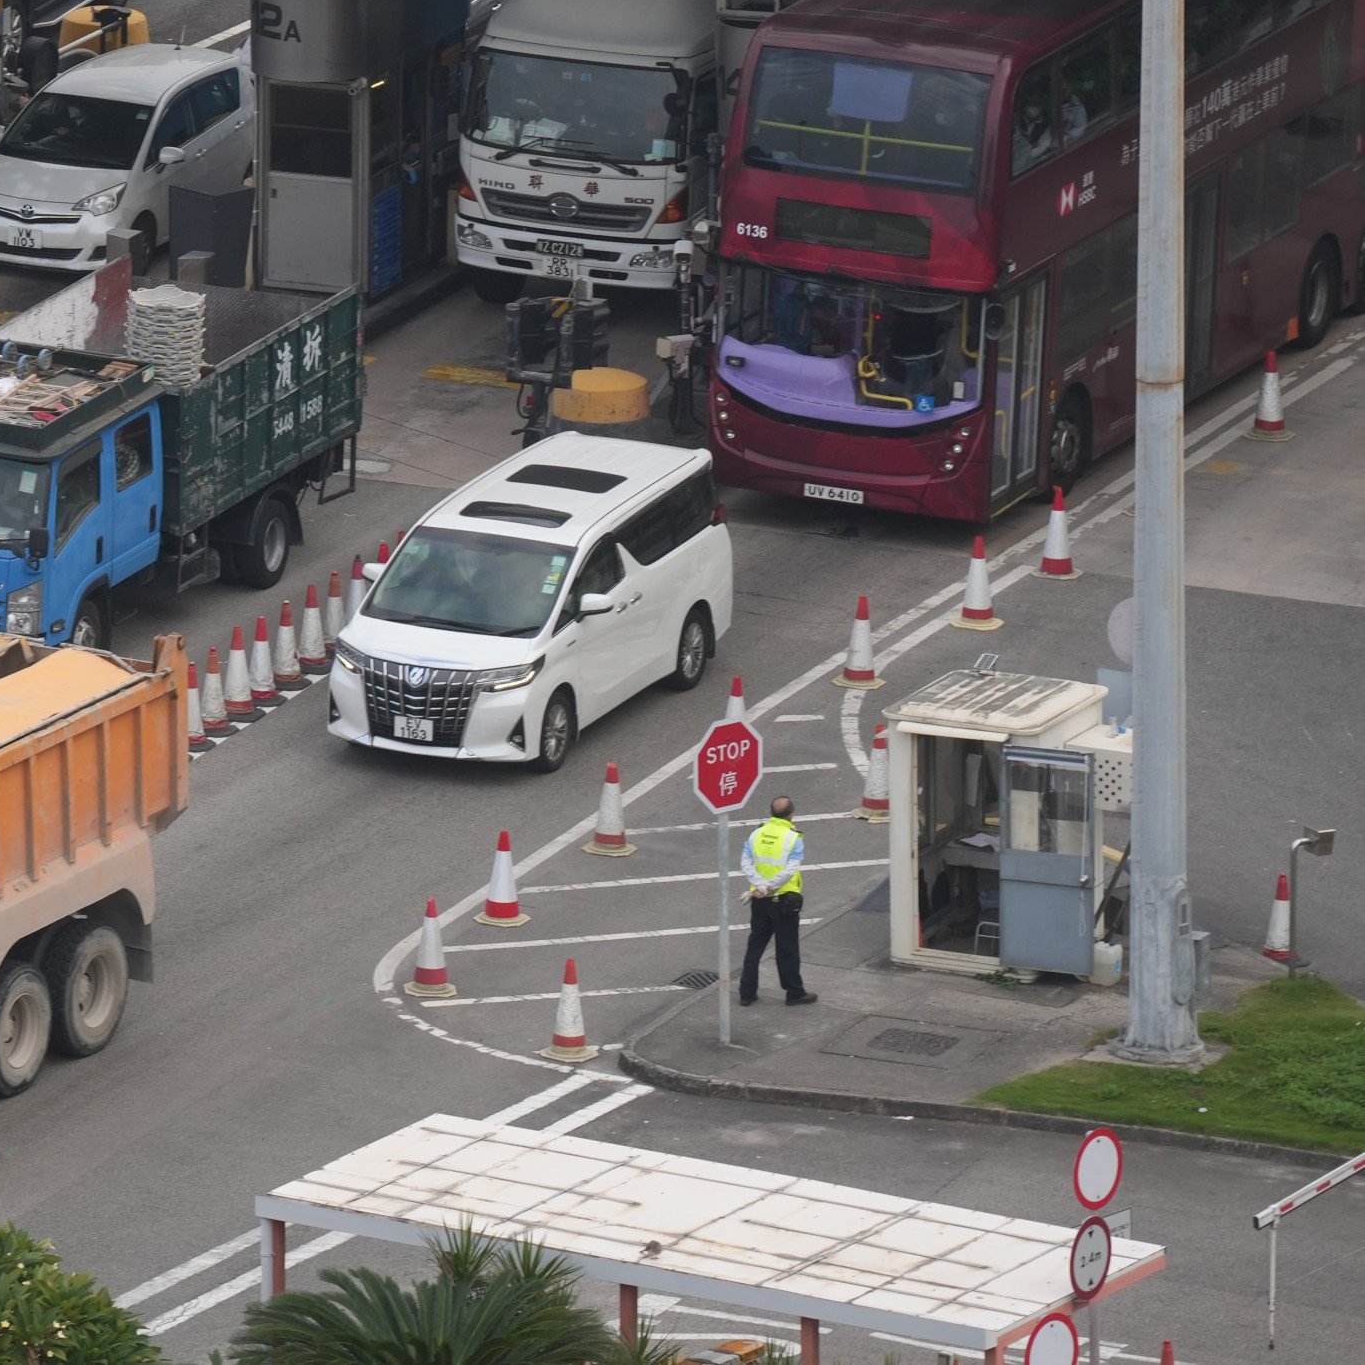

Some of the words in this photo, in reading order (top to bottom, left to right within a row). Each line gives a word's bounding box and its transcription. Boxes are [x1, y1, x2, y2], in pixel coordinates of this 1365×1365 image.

[478, 178, 515, 190] HINO
[624, 197, 655, 205] 500
[737, 223, 768, 239] 6136
[552, 257, 568, 268] RR
[546, 266, 573, 278] 3831
[808, 484, 825, 497] UV
[828, 487, 860, 502] 6410
[400, 727, 427, 740] 1163
[706, 740, 751, 764] STOP
[718, 770, 738, 797] 停
[1081, 1251, 1102, 1268] 2.4m
